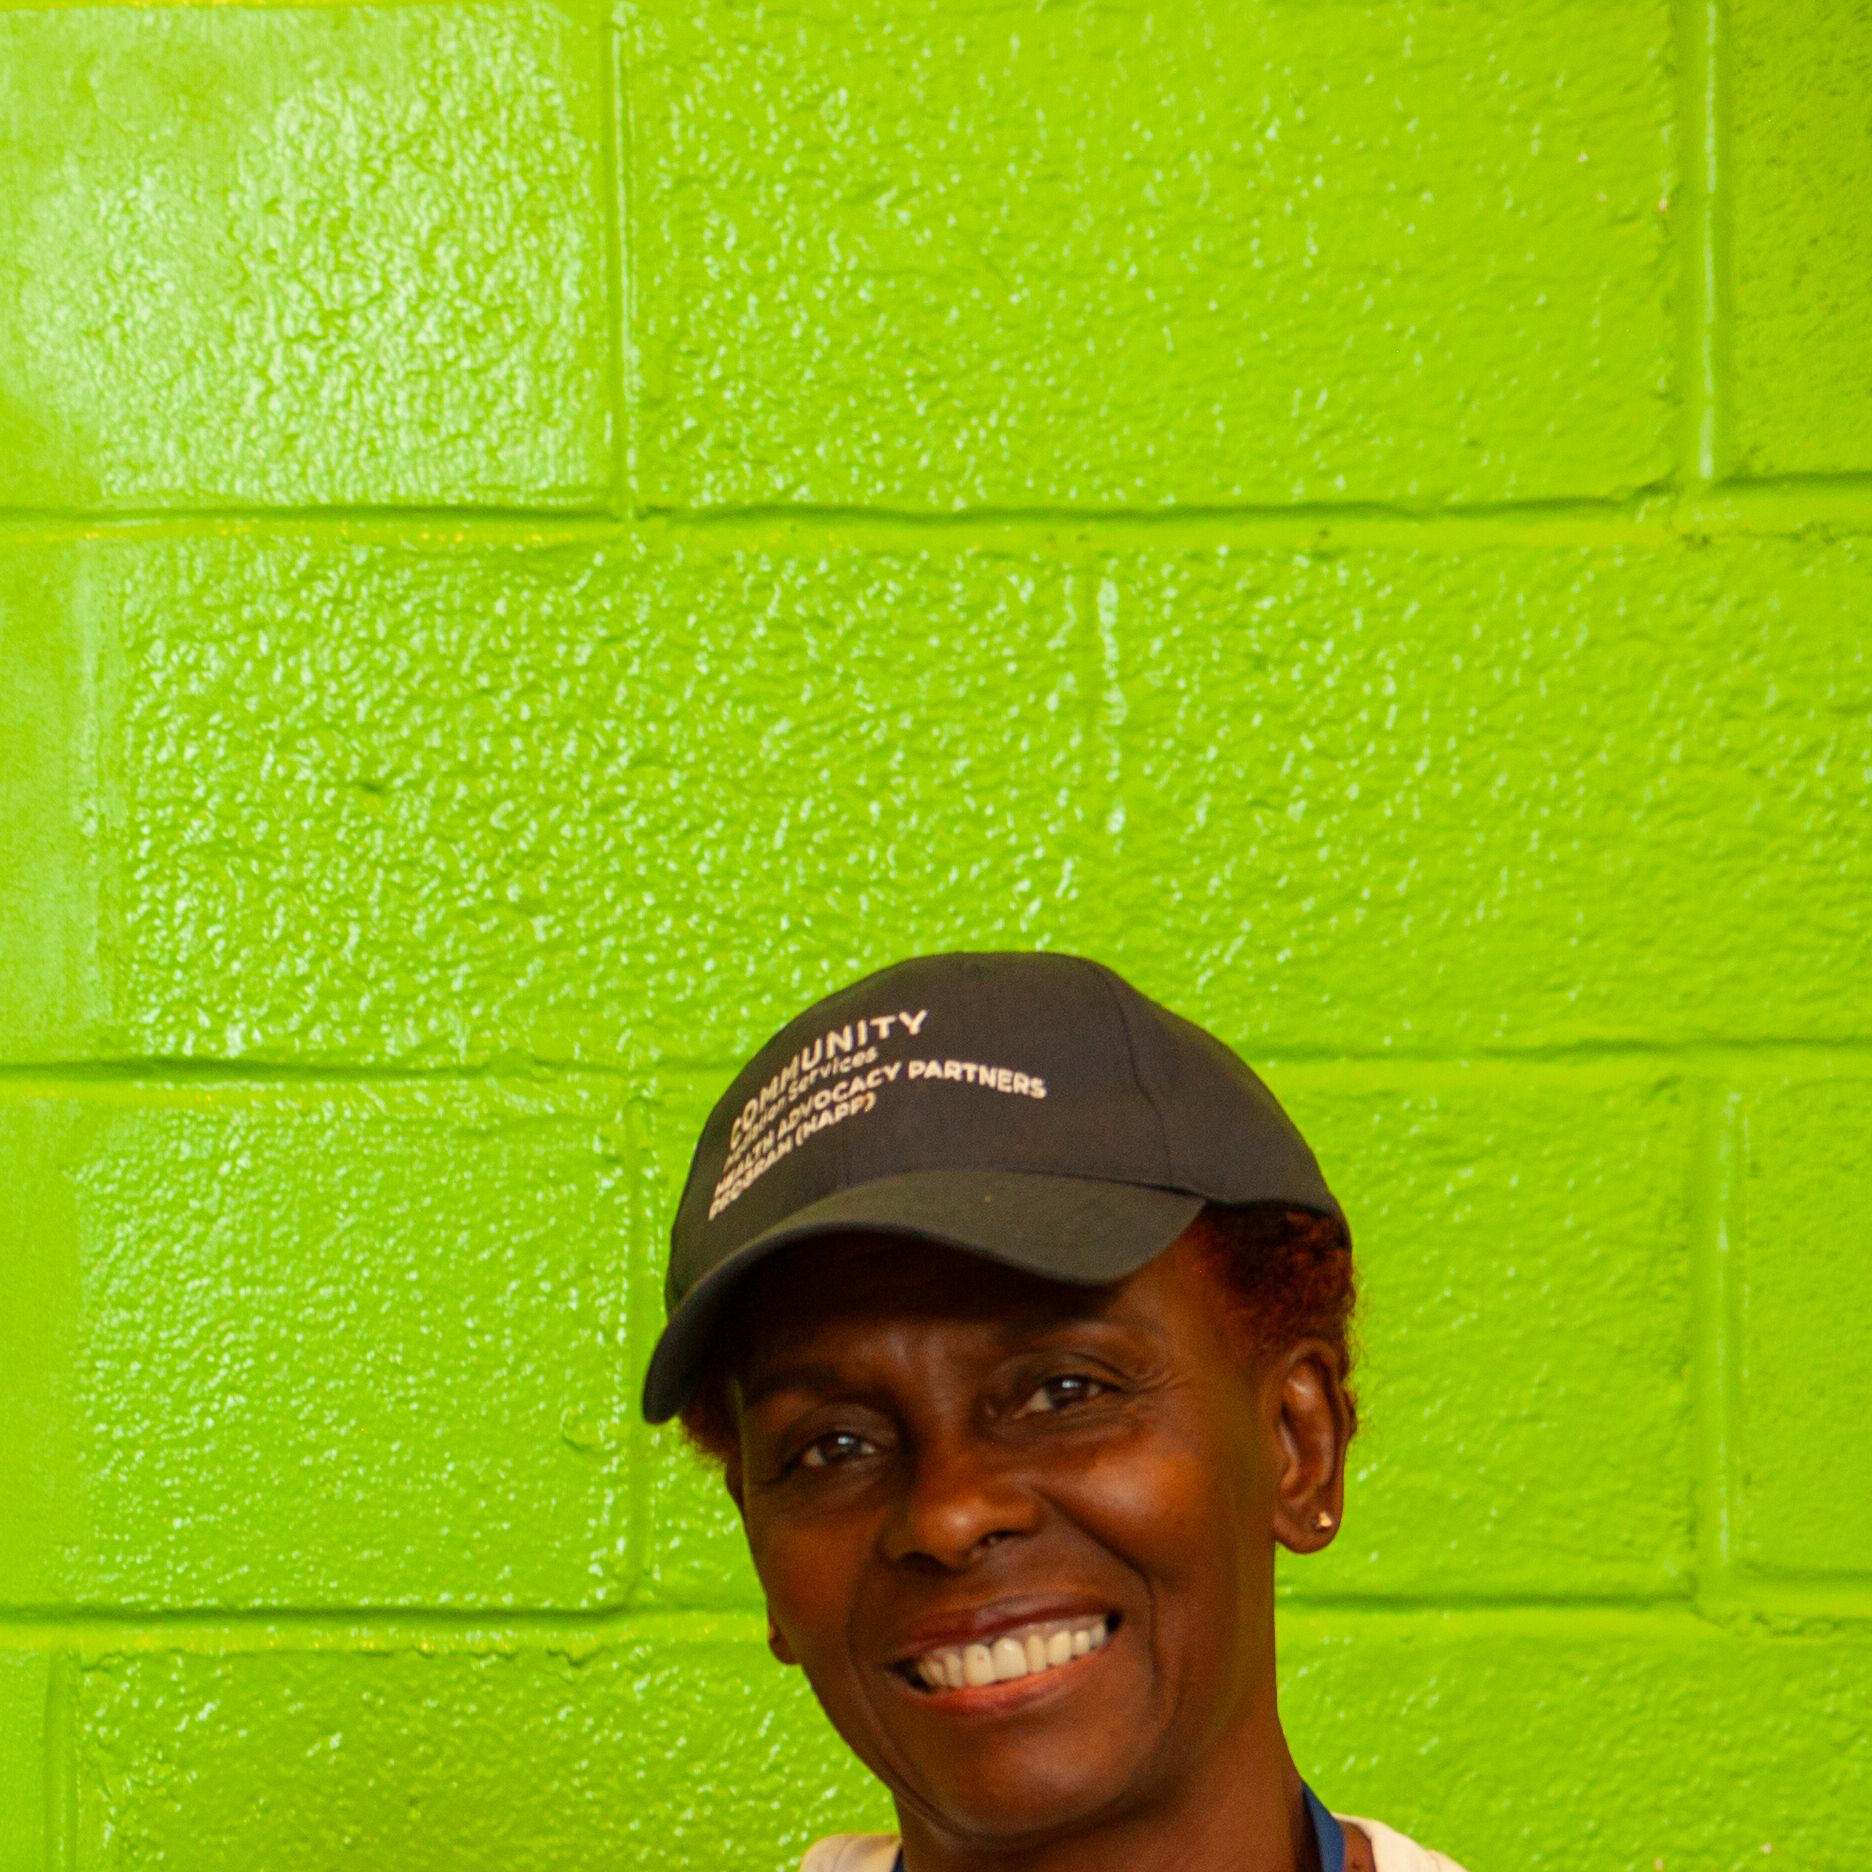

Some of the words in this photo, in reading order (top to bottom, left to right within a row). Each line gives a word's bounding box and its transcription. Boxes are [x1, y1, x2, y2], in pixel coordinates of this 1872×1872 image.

[729, 1009, 928, 1150] COMMUNITY
[777, 1061, 903, 1141] ADVOCACY
[908, 1058, 1048, 1099] PARTNERS
[787, 1046, 878, 1102] Services
[708, 1134, 794, 1221] PROGRAM
[795, 1091, 877, 1147] (HAPP)
